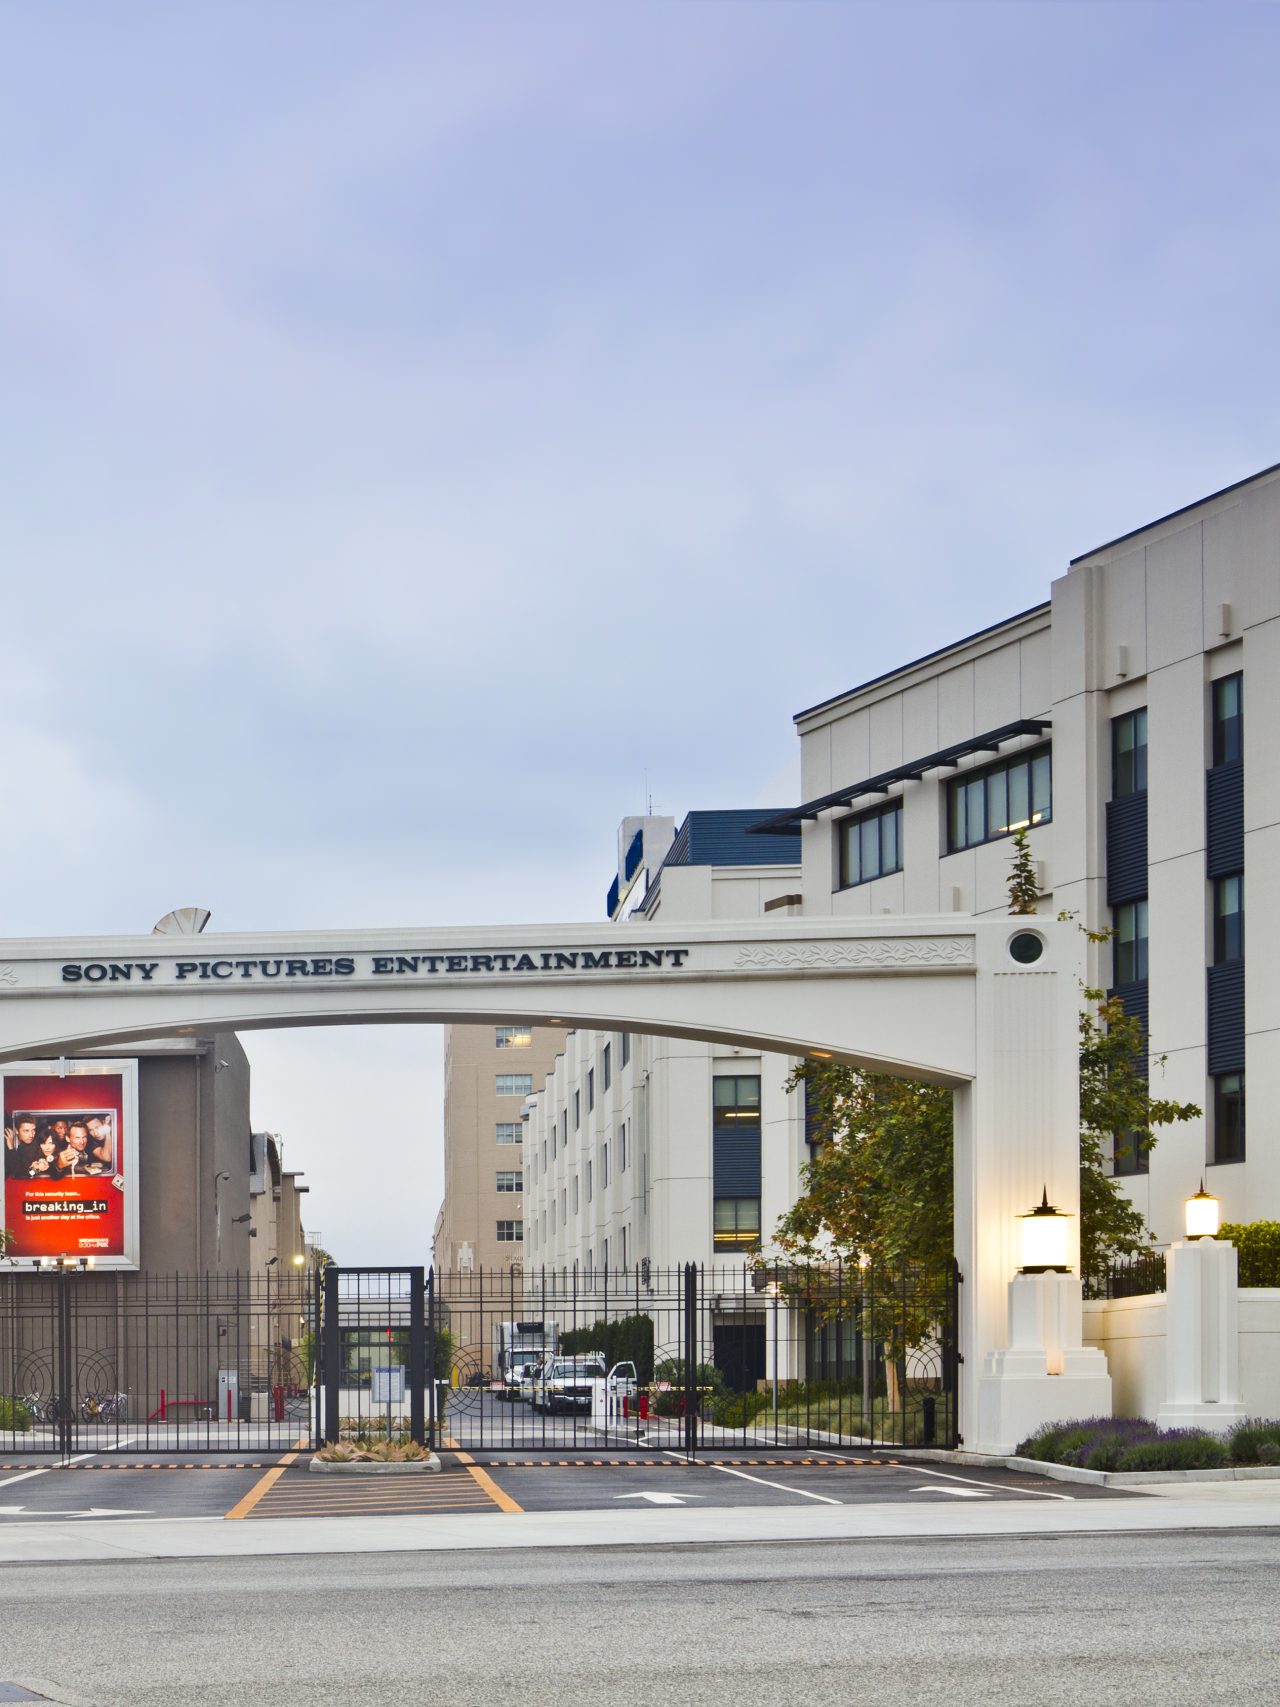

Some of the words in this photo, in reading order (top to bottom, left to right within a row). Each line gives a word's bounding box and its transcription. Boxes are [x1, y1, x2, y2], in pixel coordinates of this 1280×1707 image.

[62, 963, 159, 982] SONY
[175, 958, 355, 980] PICTURES
[371, 950, 689, 974] ENTERTAINMENT
[25, 1201, 106, 1213] breaking_in
